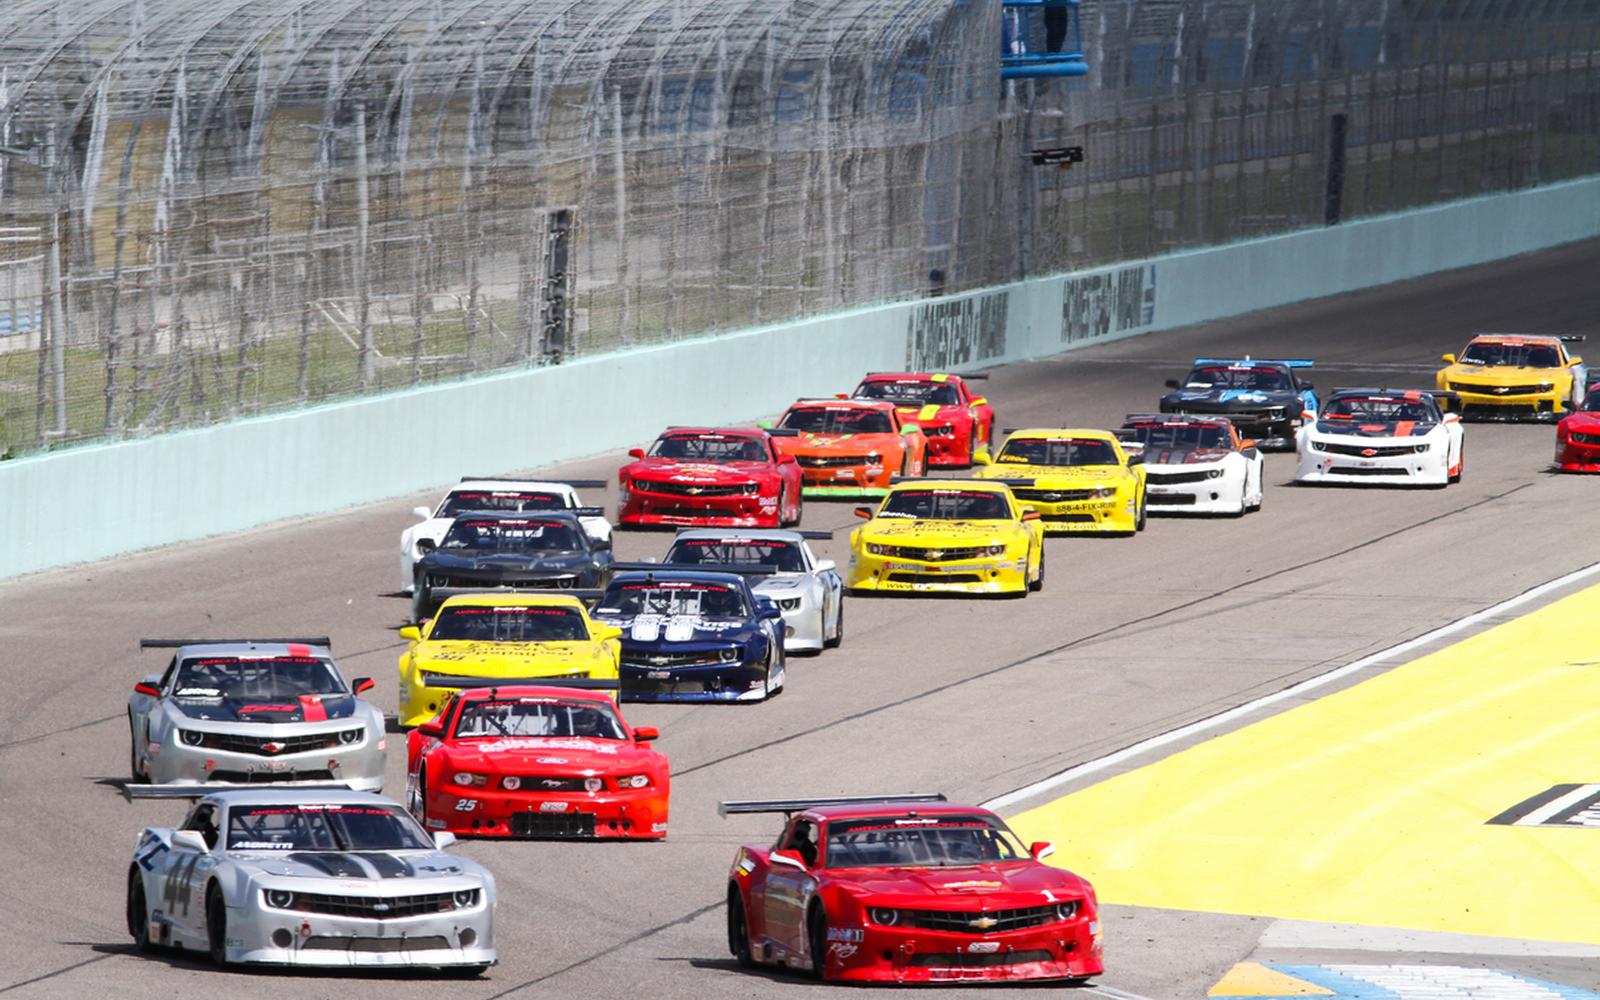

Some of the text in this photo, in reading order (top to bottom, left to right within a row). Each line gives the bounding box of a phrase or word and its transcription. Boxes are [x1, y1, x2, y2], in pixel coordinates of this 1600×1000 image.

[454, 799, 479, 811] 25
[231, 841, 294, 849] ANDRETTI
[1040, 889, 1060, 903] 1
